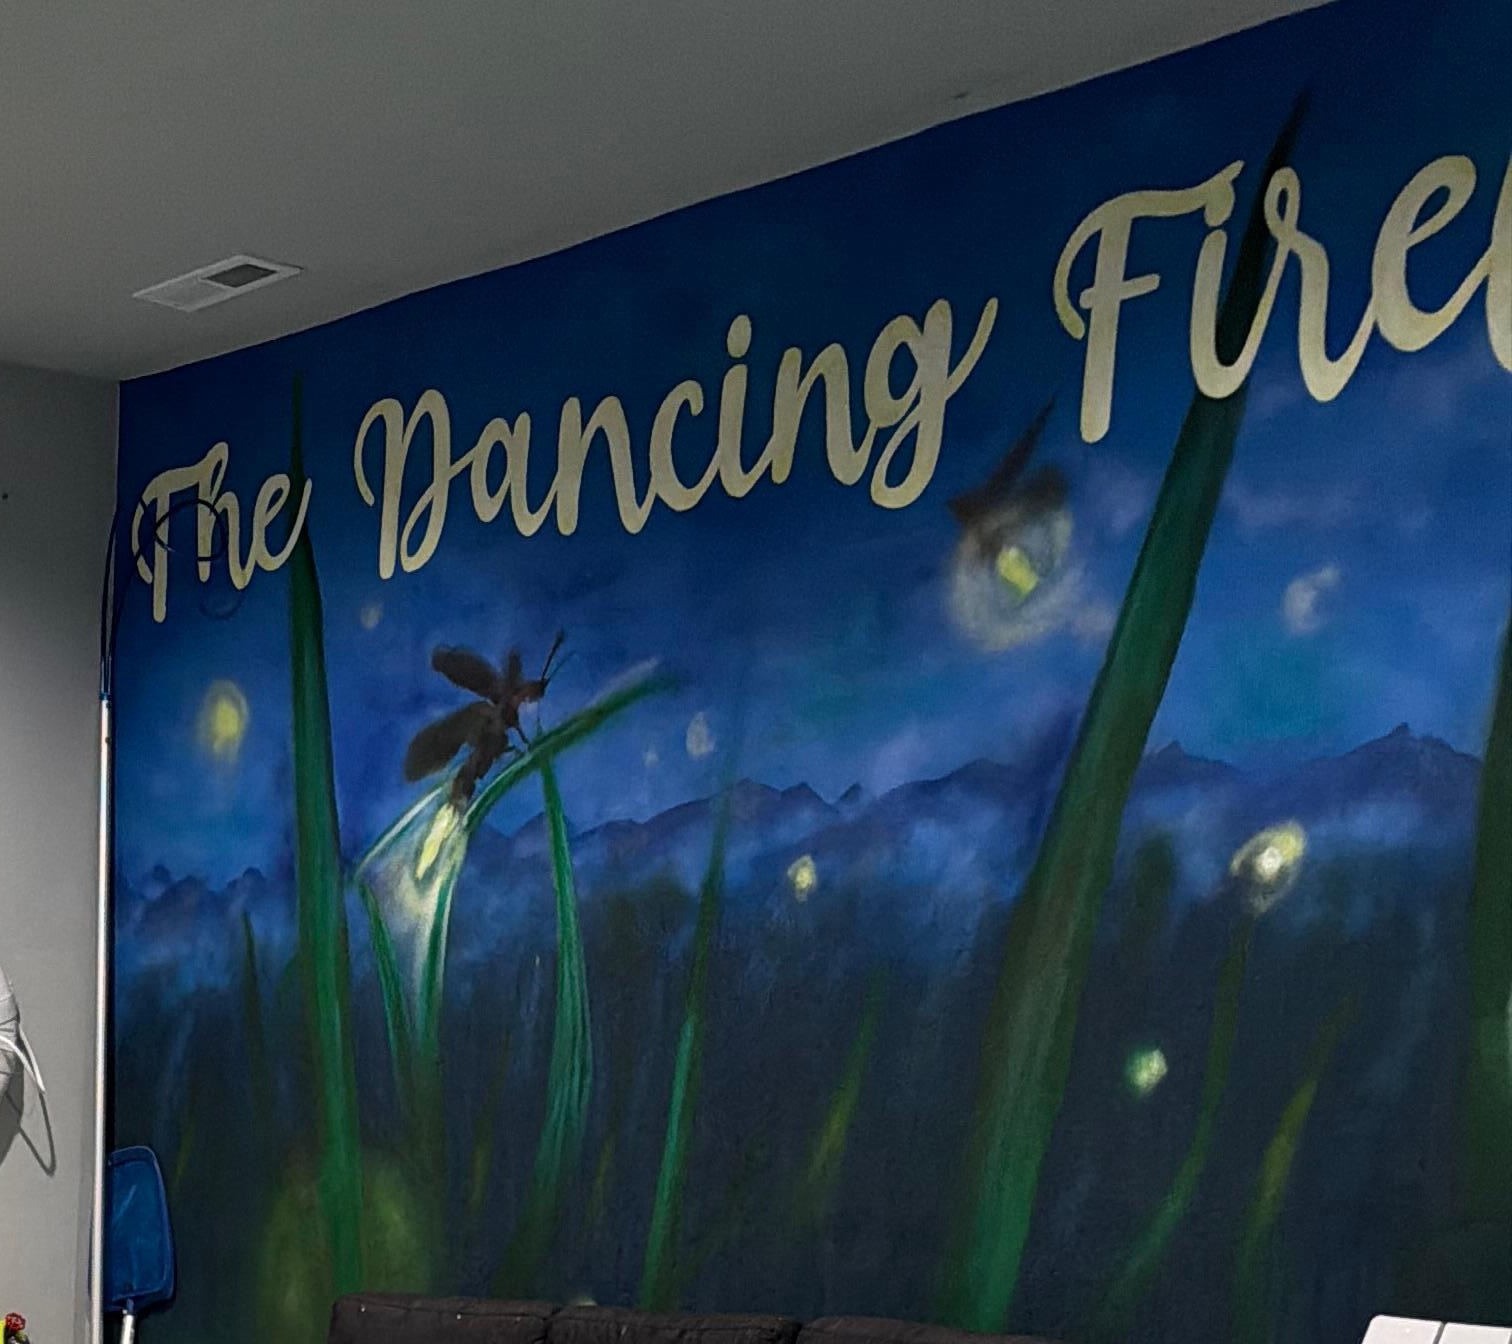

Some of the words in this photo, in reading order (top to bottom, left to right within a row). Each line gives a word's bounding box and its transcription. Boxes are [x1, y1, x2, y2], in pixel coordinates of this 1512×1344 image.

[131, 441, 312, 624] The
[353, 296, 999, 580] Dancing
[1053, 154, 1512, 444] Fire
